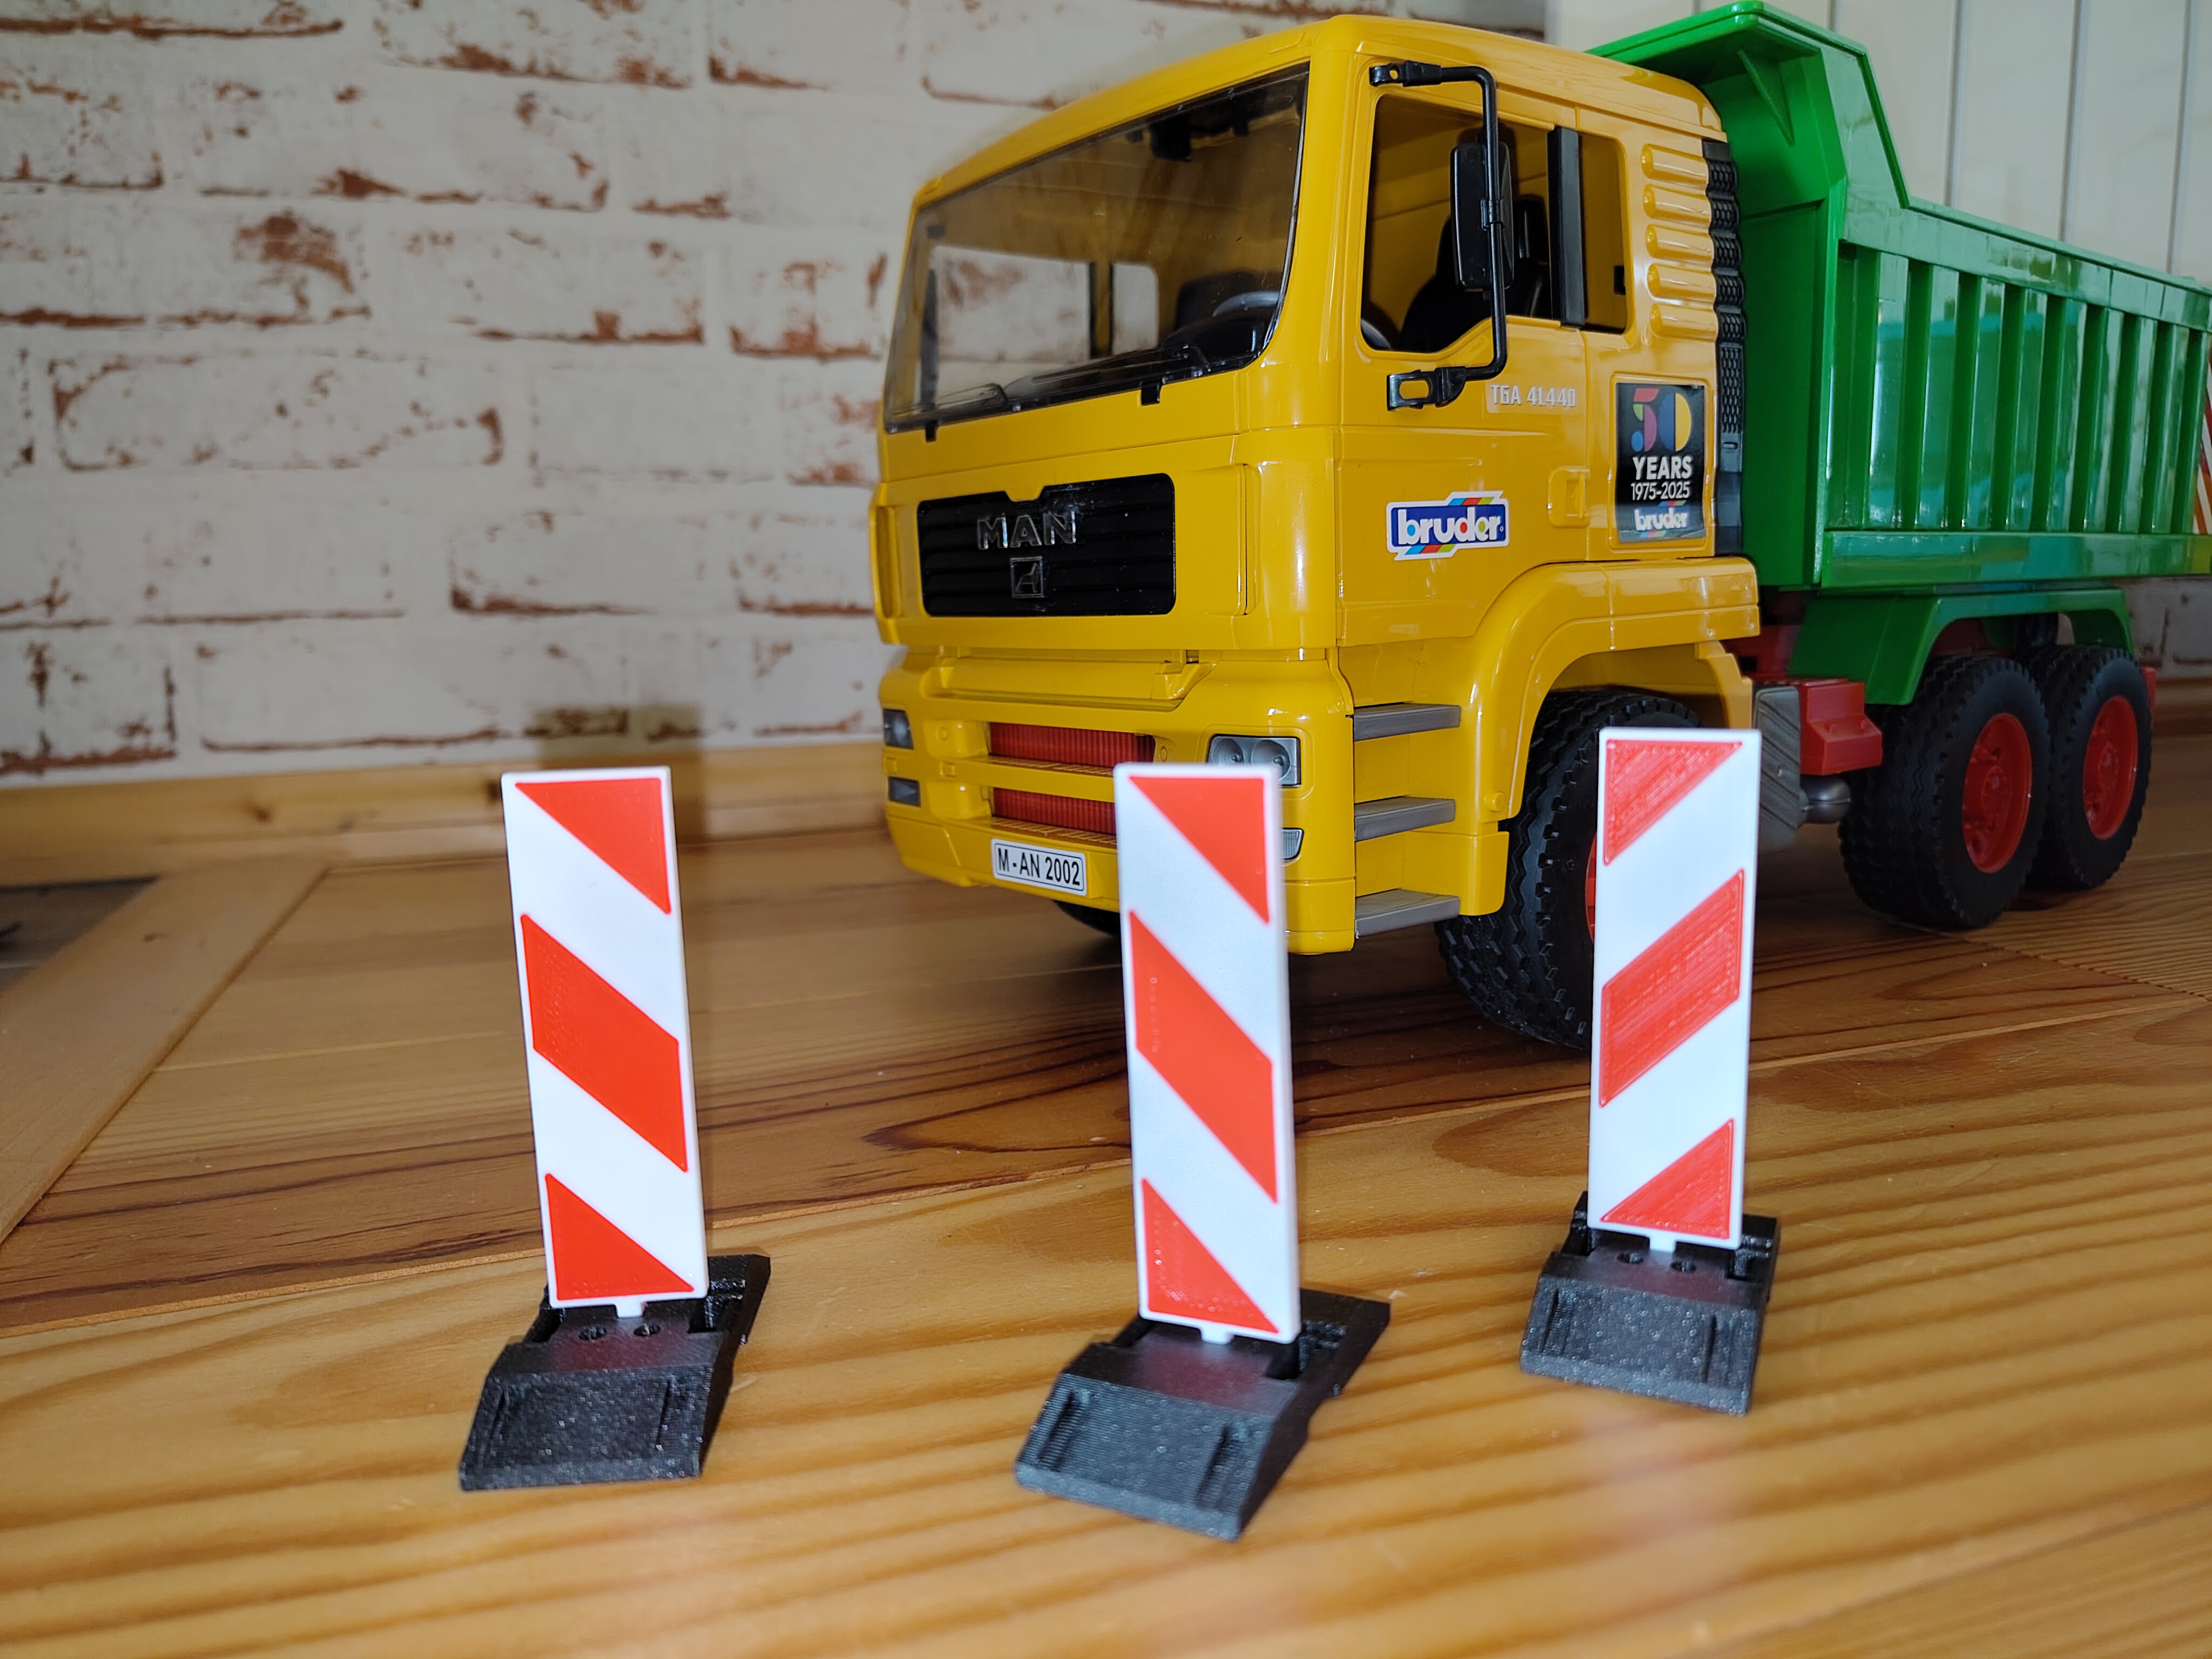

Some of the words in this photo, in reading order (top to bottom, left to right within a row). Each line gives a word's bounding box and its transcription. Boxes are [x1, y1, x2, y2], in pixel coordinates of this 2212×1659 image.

[1491, 385, 1521, 405] TGA
[1526, 386, 1576, 407] 41.440
[1631, 388, 1692, 452] 50
[1633, 456, 1692, 480] YEARS
[1631, 482, 1690, 501] 1975-2025
[977, 511, 1076, 550] MAN
[1398, 507, 1501, 545] bruder
[1634, 508, 1688, 531] bruder
[1046, 857, 1080, 886] 2002
